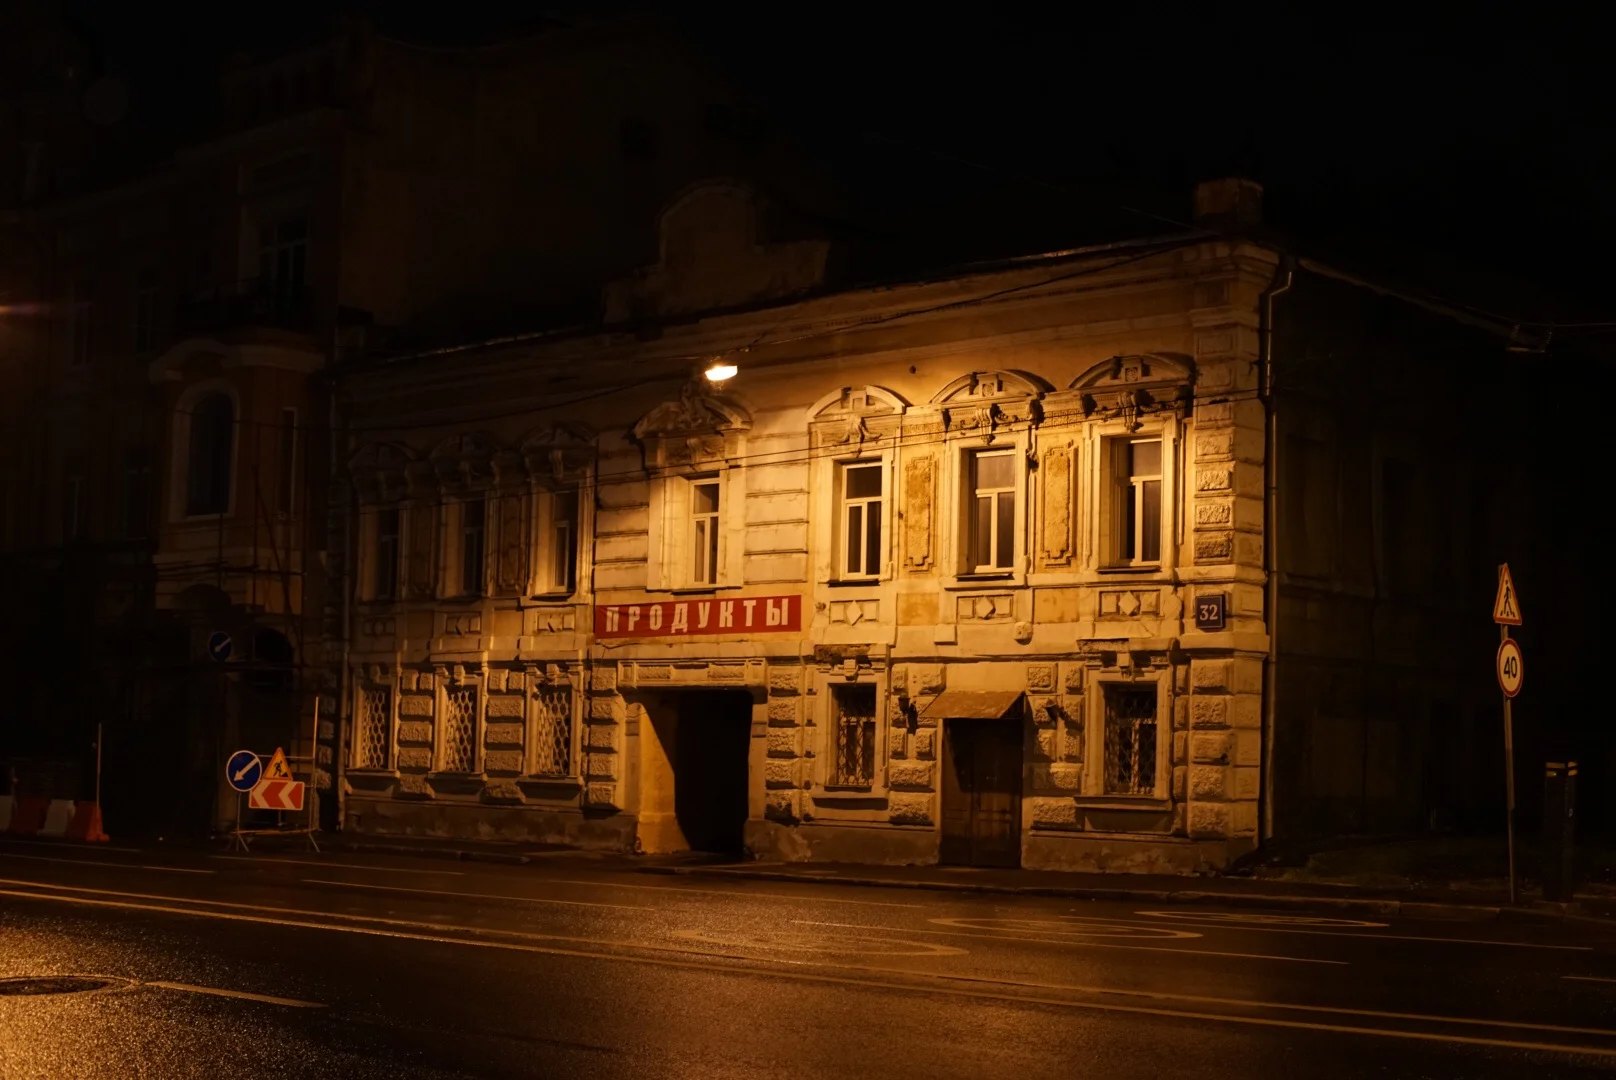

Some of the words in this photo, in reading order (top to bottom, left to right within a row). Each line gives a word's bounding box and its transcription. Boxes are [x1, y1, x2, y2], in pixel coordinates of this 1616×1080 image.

[605, 598, 789, 634] ПРОДУКТЫ
[1199, 604, 1219, 621] 32
[1503, 655, 1518, 679] 40
